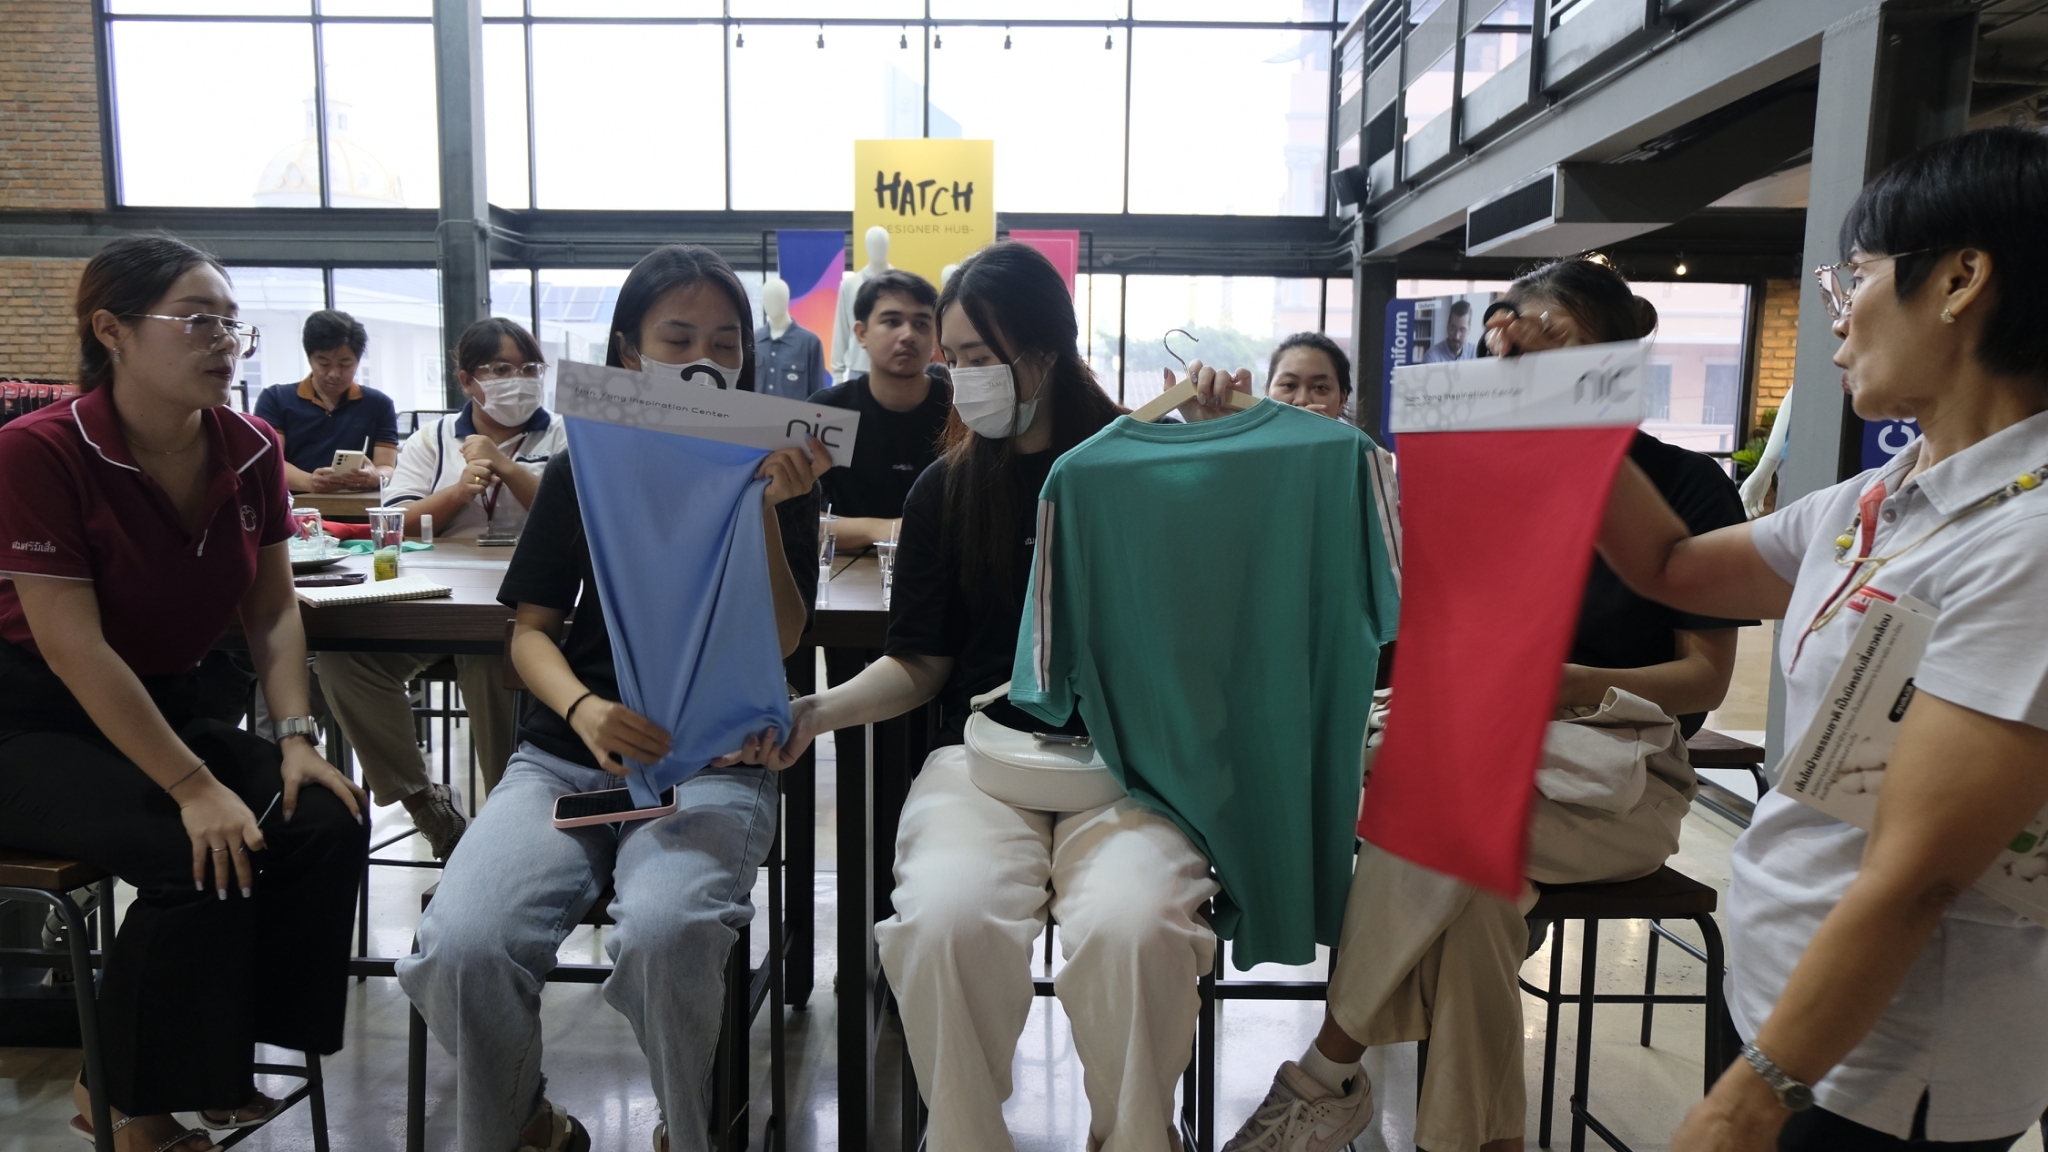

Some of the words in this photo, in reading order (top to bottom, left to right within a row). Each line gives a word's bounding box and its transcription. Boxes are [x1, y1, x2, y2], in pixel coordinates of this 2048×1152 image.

[874, 170, 973, 217] HATCH
[1573, 353, 1639, 405] nic
[629, 396, 688, 412] Inspiration
[691, 406, 730, 418] Center
[786, 413, 844, 448] nic
